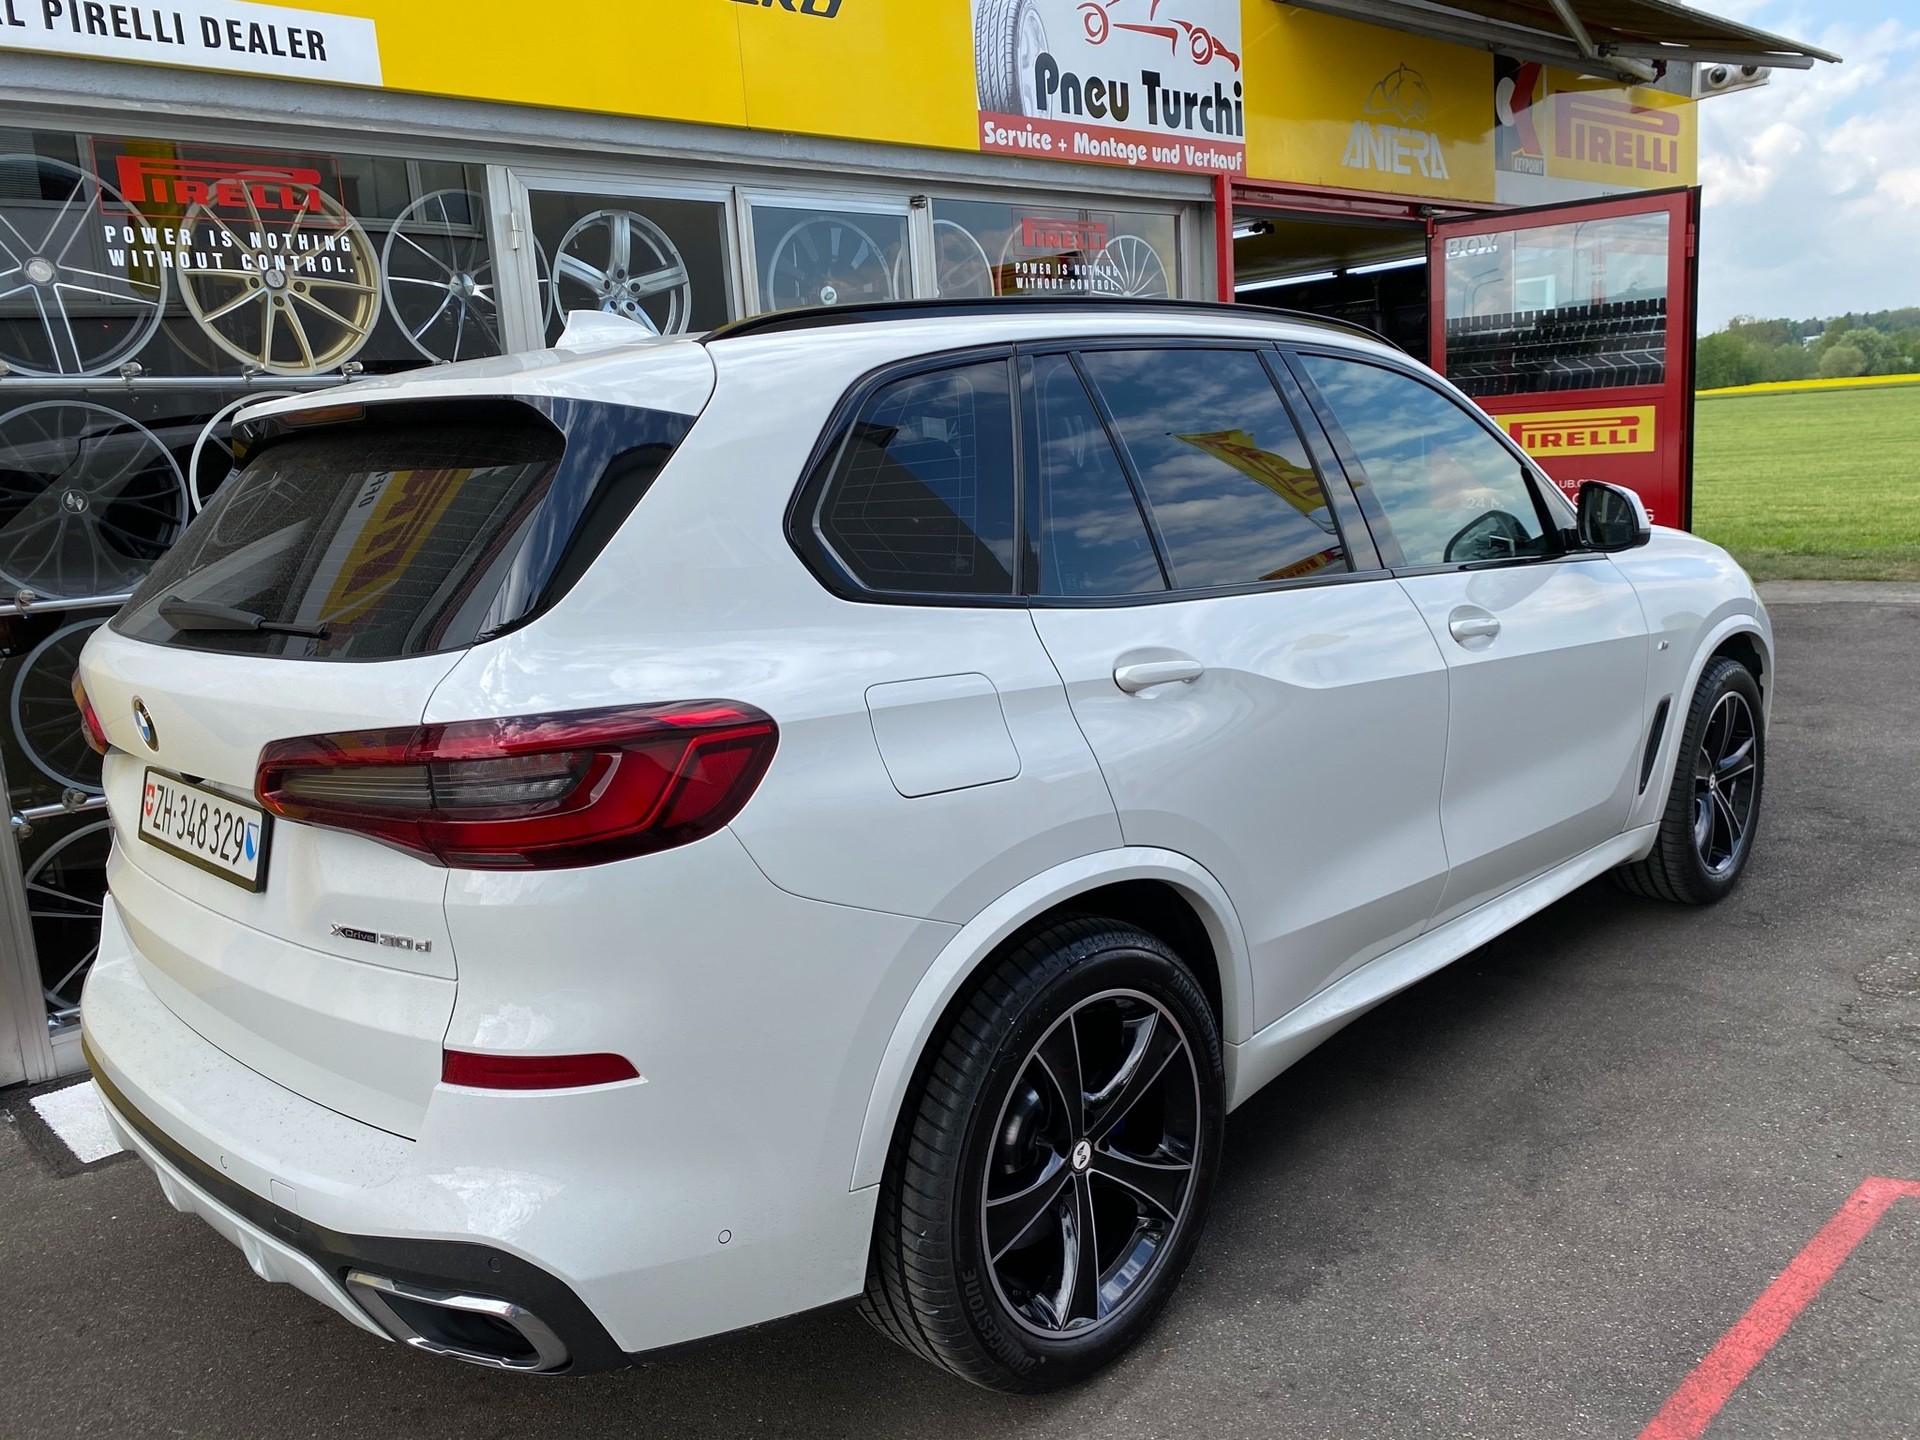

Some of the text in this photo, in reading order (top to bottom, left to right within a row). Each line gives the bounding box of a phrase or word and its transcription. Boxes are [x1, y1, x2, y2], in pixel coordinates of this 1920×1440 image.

[41, 0, 185, 45] PIRELLI
[199, 15, 327, 61] DEALER
[1034, 52, 1243, 137] Pneu Turchi
[984, 121, 1242, 171] Service + Montage und Verkauf
[1341, 120, 1449, 180] ANTERA
[1555, 90, 1680, 174] PIRELLI
[115, 155, 321, 212] PIRELLI
[104, 225, 351, 252] POWER IS NOTHING
[1022, 217, 1107, 250] PIRELLI
[107, 249, 354, 273] WITHOUT CONTROL.
[1015, 262, 1118, 277] POWER IS NOTHING
[1016, 277, 1119, 291] WITHOUT CONTROL.
[1509, 416, 1640, 449] PIRELLI
